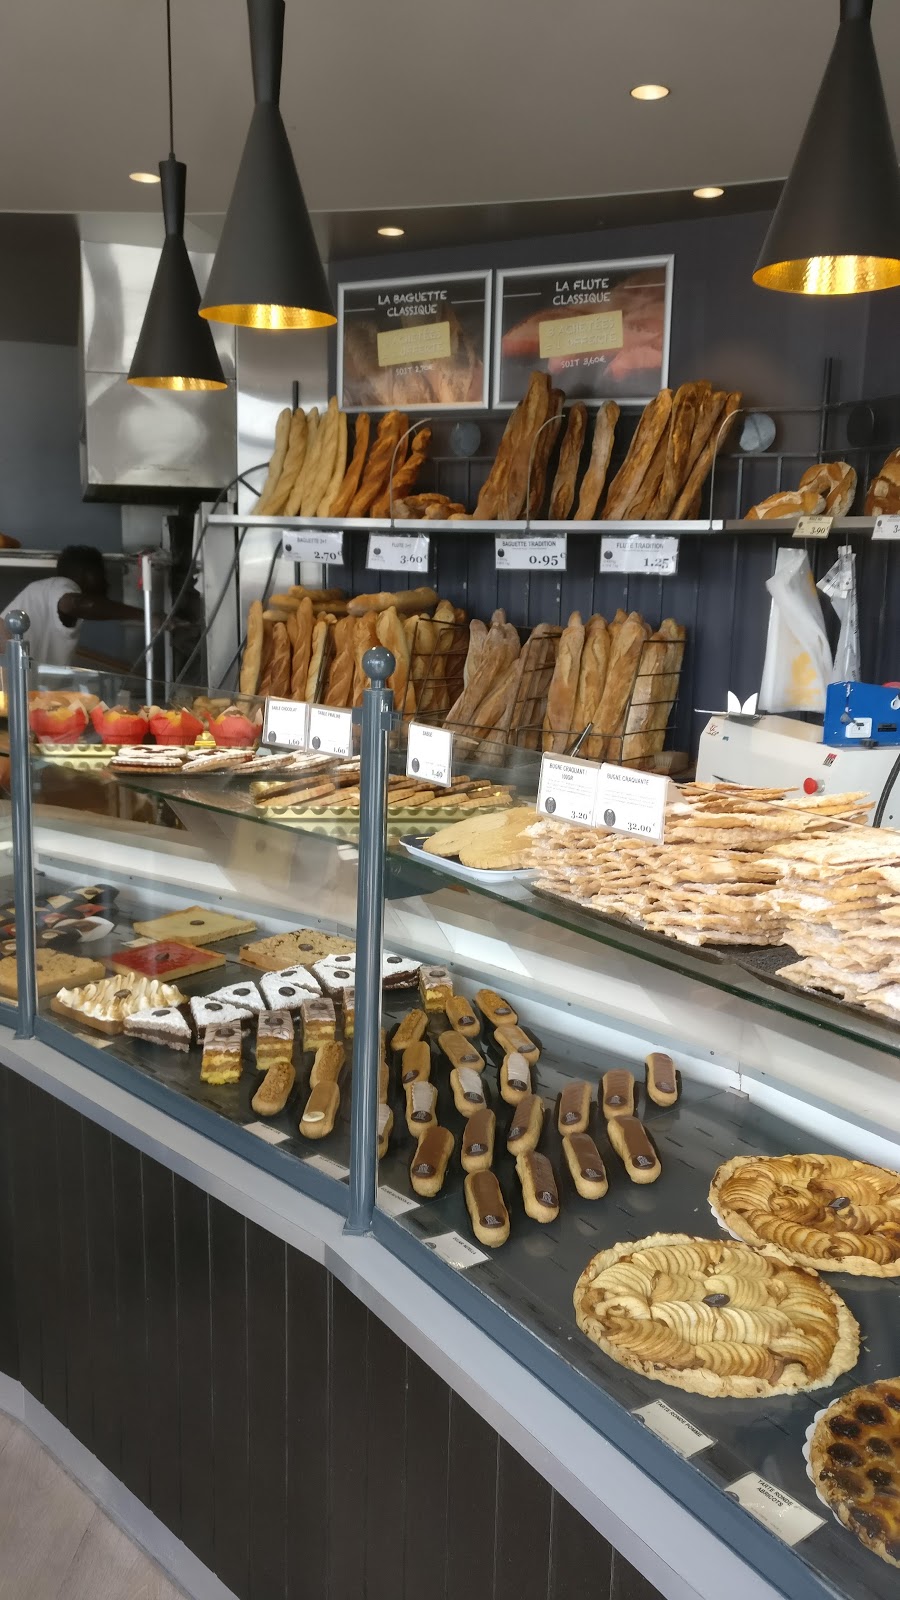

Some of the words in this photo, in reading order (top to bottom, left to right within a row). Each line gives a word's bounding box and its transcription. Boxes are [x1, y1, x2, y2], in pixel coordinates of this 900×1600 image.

[555, 281, 570, 292] LA
[573, 278, 609, 290] FLUTE
[377, 294, 391, 306] LA
[393, 290, 448, 304] BAGUETTE
[552, 292, 611, 306] CLASSIQUE
[386, 304, 438, 317] CLASSIQUE
[561, 358, 580, 368] SOIT
[395, 366, 413, 376] SOIT
[563, 765, 585, 774] CRAQUANT
[606, 773, 622, 781] BUGNE
[621, 775, 650, 785] CRAQUANTE
[655, 1401, 672, 1415] TARTE
[669, 1410, 687, 1424] RONDE
[685, 1422, 703, 1437] POMME
[757, 1487, 784, 1507] ABRICOTS
[758, 1480, 774, 1493] TARTE
[773, 1491, 794, 1506] RONDE
